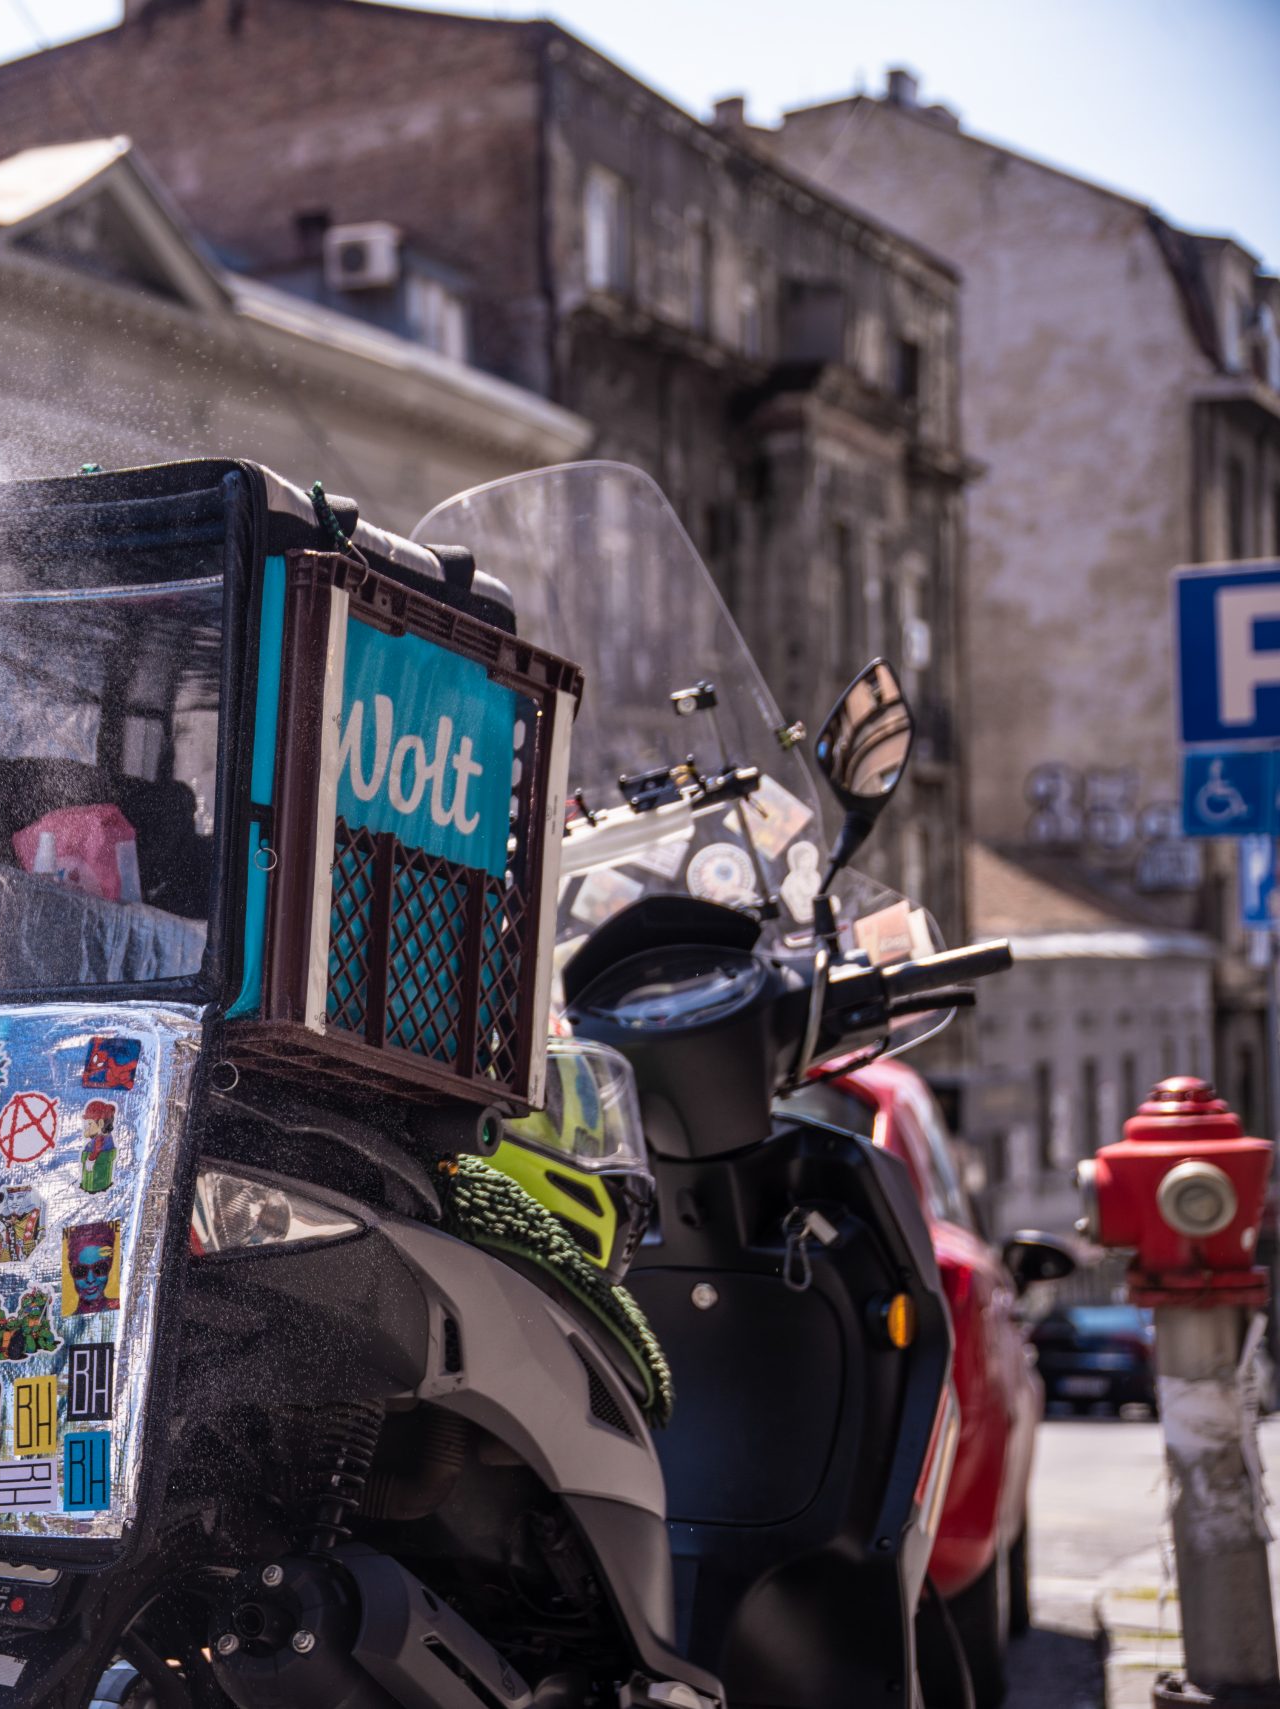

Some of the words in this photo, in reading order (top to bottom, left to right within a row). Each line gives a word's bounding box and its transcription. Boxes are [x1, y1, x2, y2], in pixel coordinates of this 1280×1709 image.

[337, 693, 483, 835] Wolt
[16, 1382, 52, 1449] BH
[72, 1349, 110, 1415] BH
[69, 1438, 107, 1505] BH
